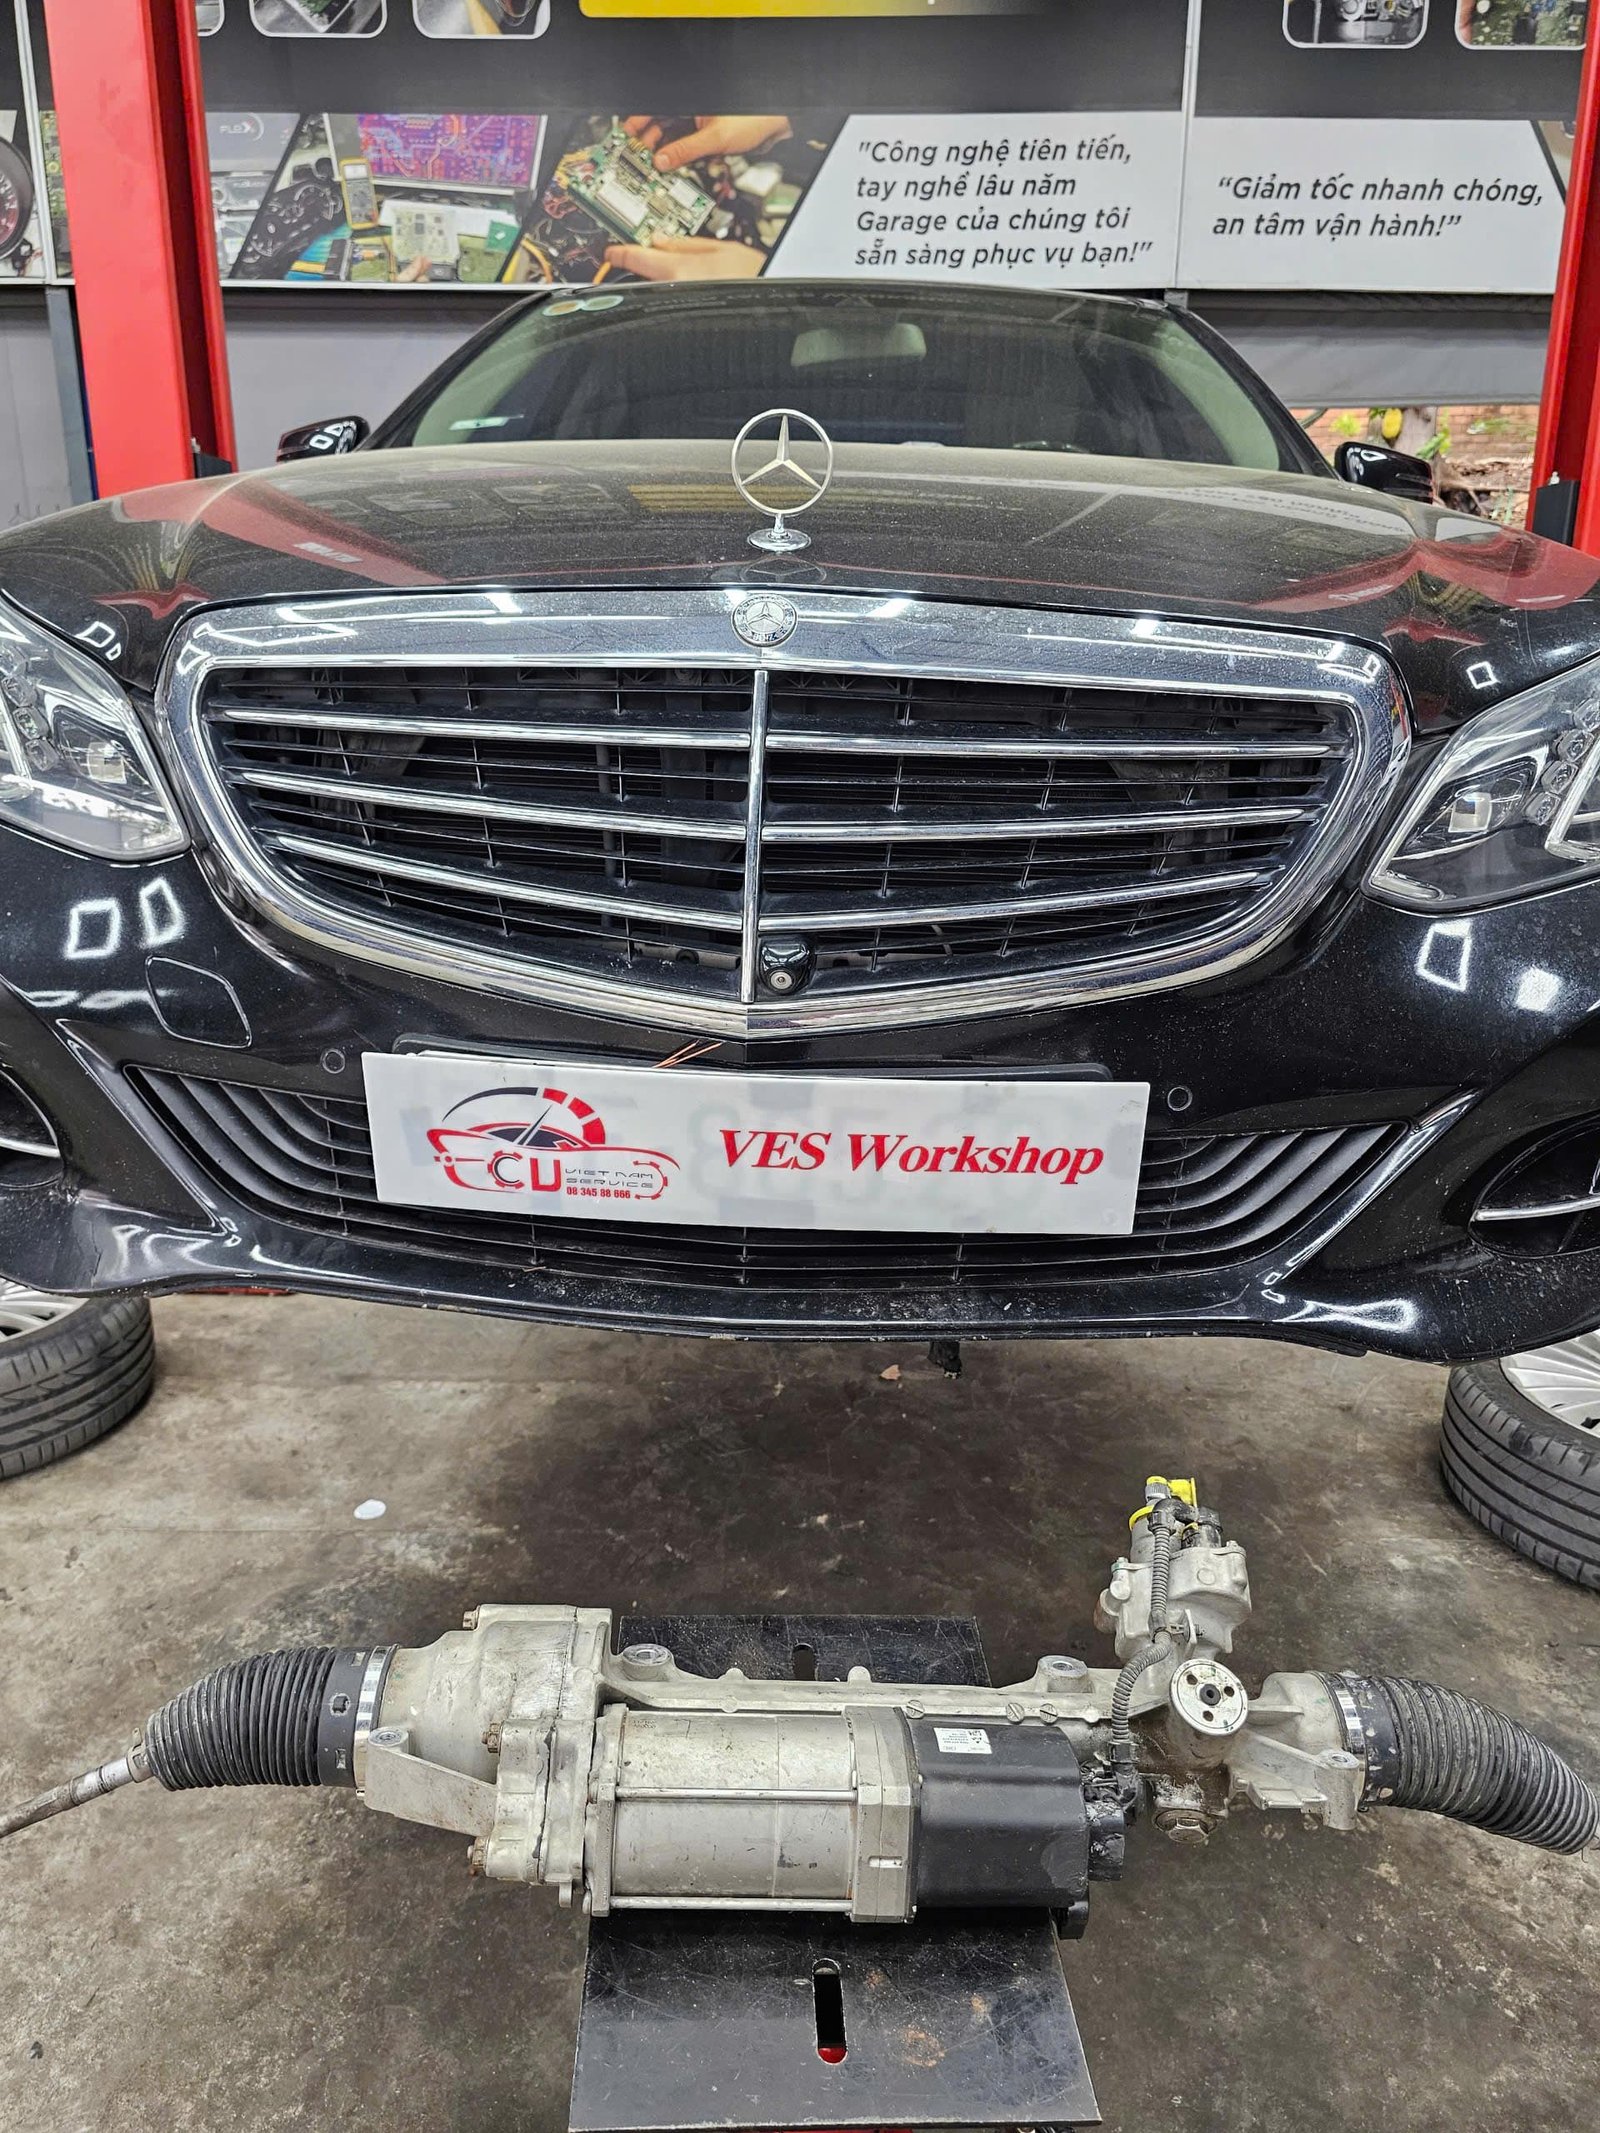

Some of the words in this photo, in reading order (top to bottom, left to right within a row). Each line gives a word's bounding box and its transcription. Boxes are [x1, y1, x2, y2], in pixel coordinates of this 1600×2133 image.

[859, 140, 938, 166] "Công
[945, 139, 1010, 167] nghệ
[1019, 138, 1067, 161] tiên
[1076, 133, 1132, 164] tiến,
[857, 177, 897, 201] tay
[904, 171, 970, 200] nghề
[976, 174, 1014, 196] lâu
[1022, 173, 1077, 196] năm
[1310, 172, 1353, 200] tốc
[1361, 178, 1444, 201] nhanh
[1453, 178, 1543, 206] chóng,
[857, 211, 947, 235] Garage
[956, 206, 999, 230] của
[1009, 207, 1087, 233] chúng
[1095, 206, 1132, 229] tôi
[1213, 217, 1245, 235] an
[1254, 212, 1305, 236] tâm
[1315, 213, 1361, 241] vận
[855, 238, 897, 265] sẵn
[972, 243, 1036, 269] phục
[1045, 247, 1074, 269] vụ
[719, 1129, 832, 1171] VES
[847, 1133, 1105, 1185] Workshop
[580, 1187, 597, 1197] 345
